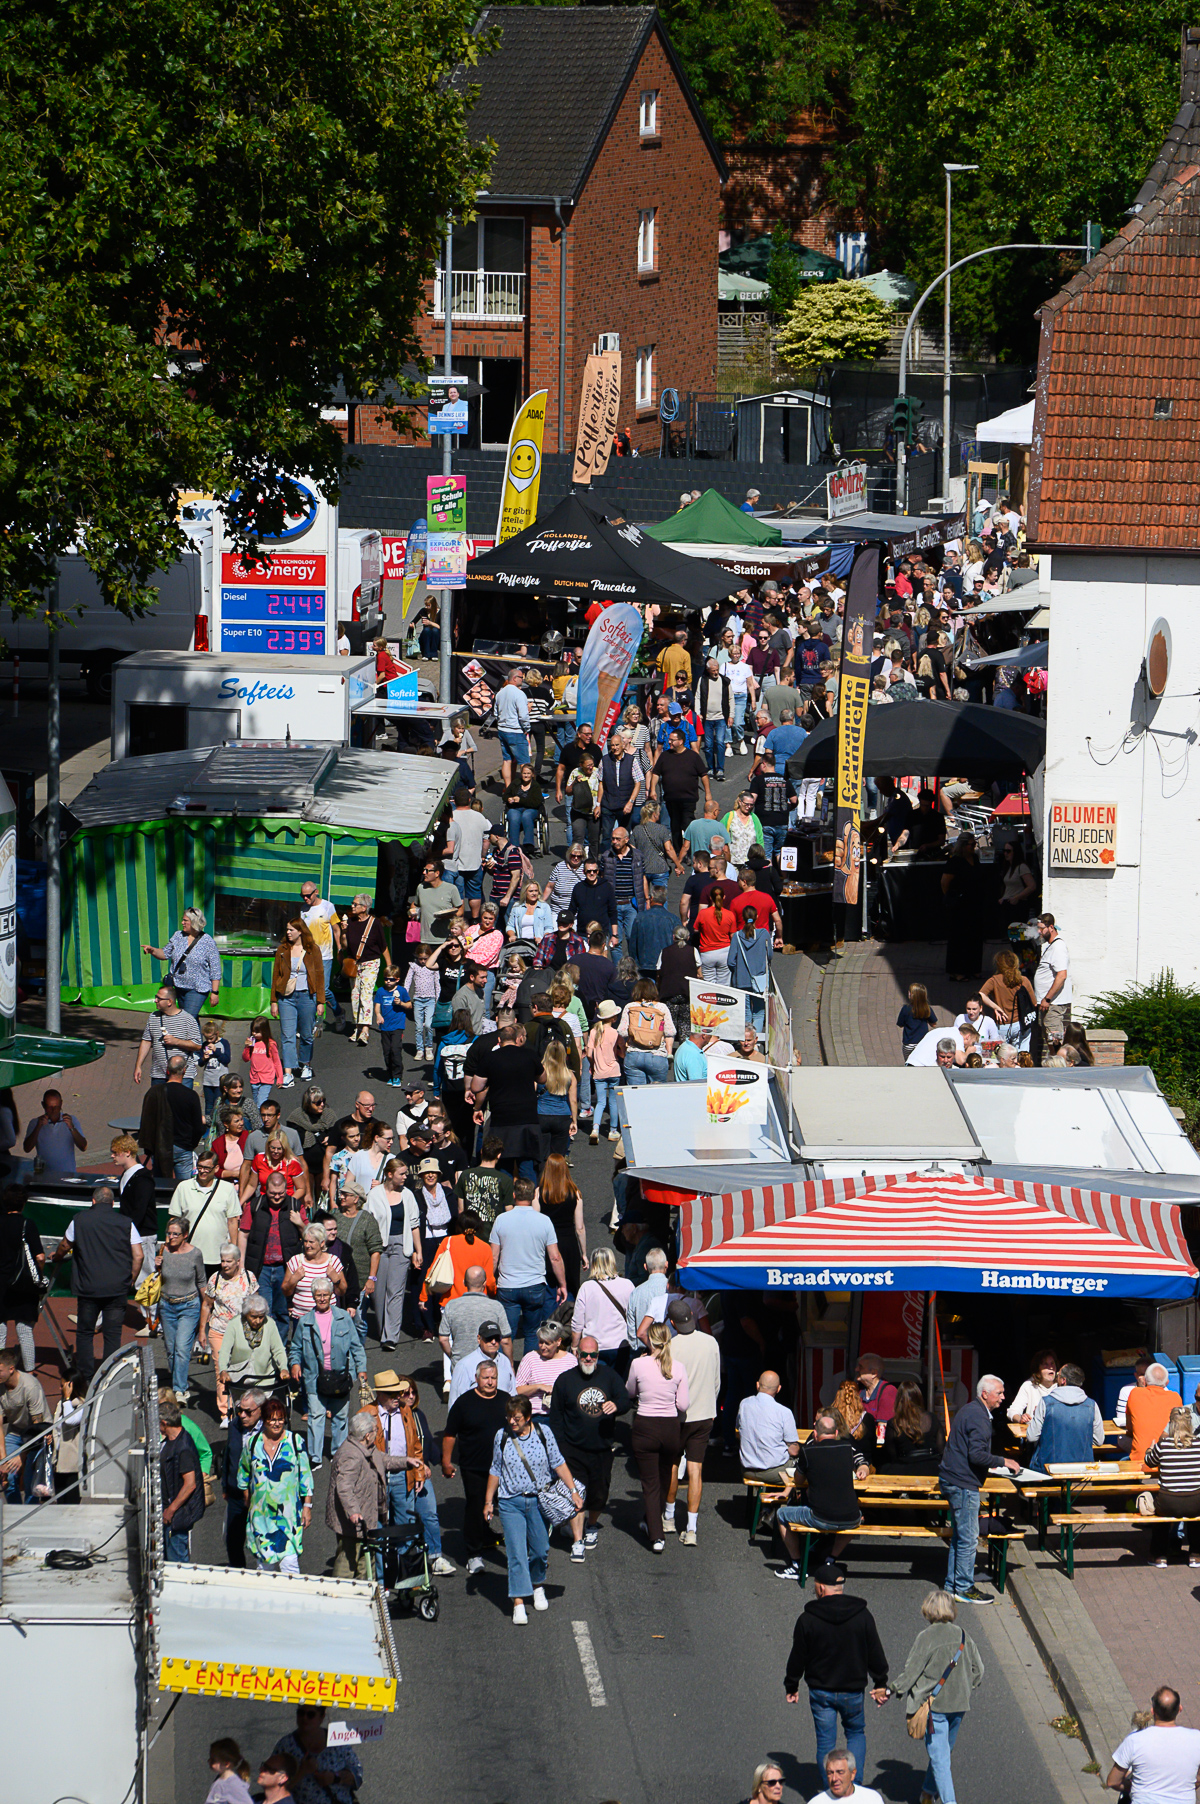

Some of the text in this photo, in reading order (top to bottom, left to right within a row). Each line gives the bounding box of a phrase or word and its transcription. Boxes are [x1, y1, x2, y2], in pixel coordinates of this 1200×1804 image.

[526, 408, 544, 420] ADAC
[576, 367, 604, 468] Poffertjes
[832, 469, 864, 498] Gewürze
[441, 491, 463, 502] Schule
[433, 501, 457, 513] für alle
[502, 516, 524, 525] rteile
[526, 539, 593, 554] Poffertjes
[256, 561, 317, 580] Synergy
[465, 574, 494, 582] OLLANDSE
[496, 572, 541, 588] Poffertjes
[554, 579, 574, 587] DUTCH
[590, 579, 637, 594] Pancakes
[223, 592, 247, 601] Diesel
[223, 628, 262, 639] Super E10
[600, 618, 633, 644] Softeis
[217, 677, 296, 706] Softeis
[389, 688, 416, 700] Softeis
[841, 680, 853, 802] Gebrannte
[850, 681, 867, 805] Mandeln
[1053, 806, 1116, 824] BLUMEN
[1053, 825, 1114, 844] FÜR JEDEN
[1052, 848, 1099, 864] ANLASS
[736, 1073, 758, 1081] FRITES
[766, 1268, 894, 1286] Braadworst
[981, 1270, 1108, 1293] Hamburger
[196, 1669, 358, 1699] ENTENANGELN
[329, 1723, 383, 1743] Angelspiel
